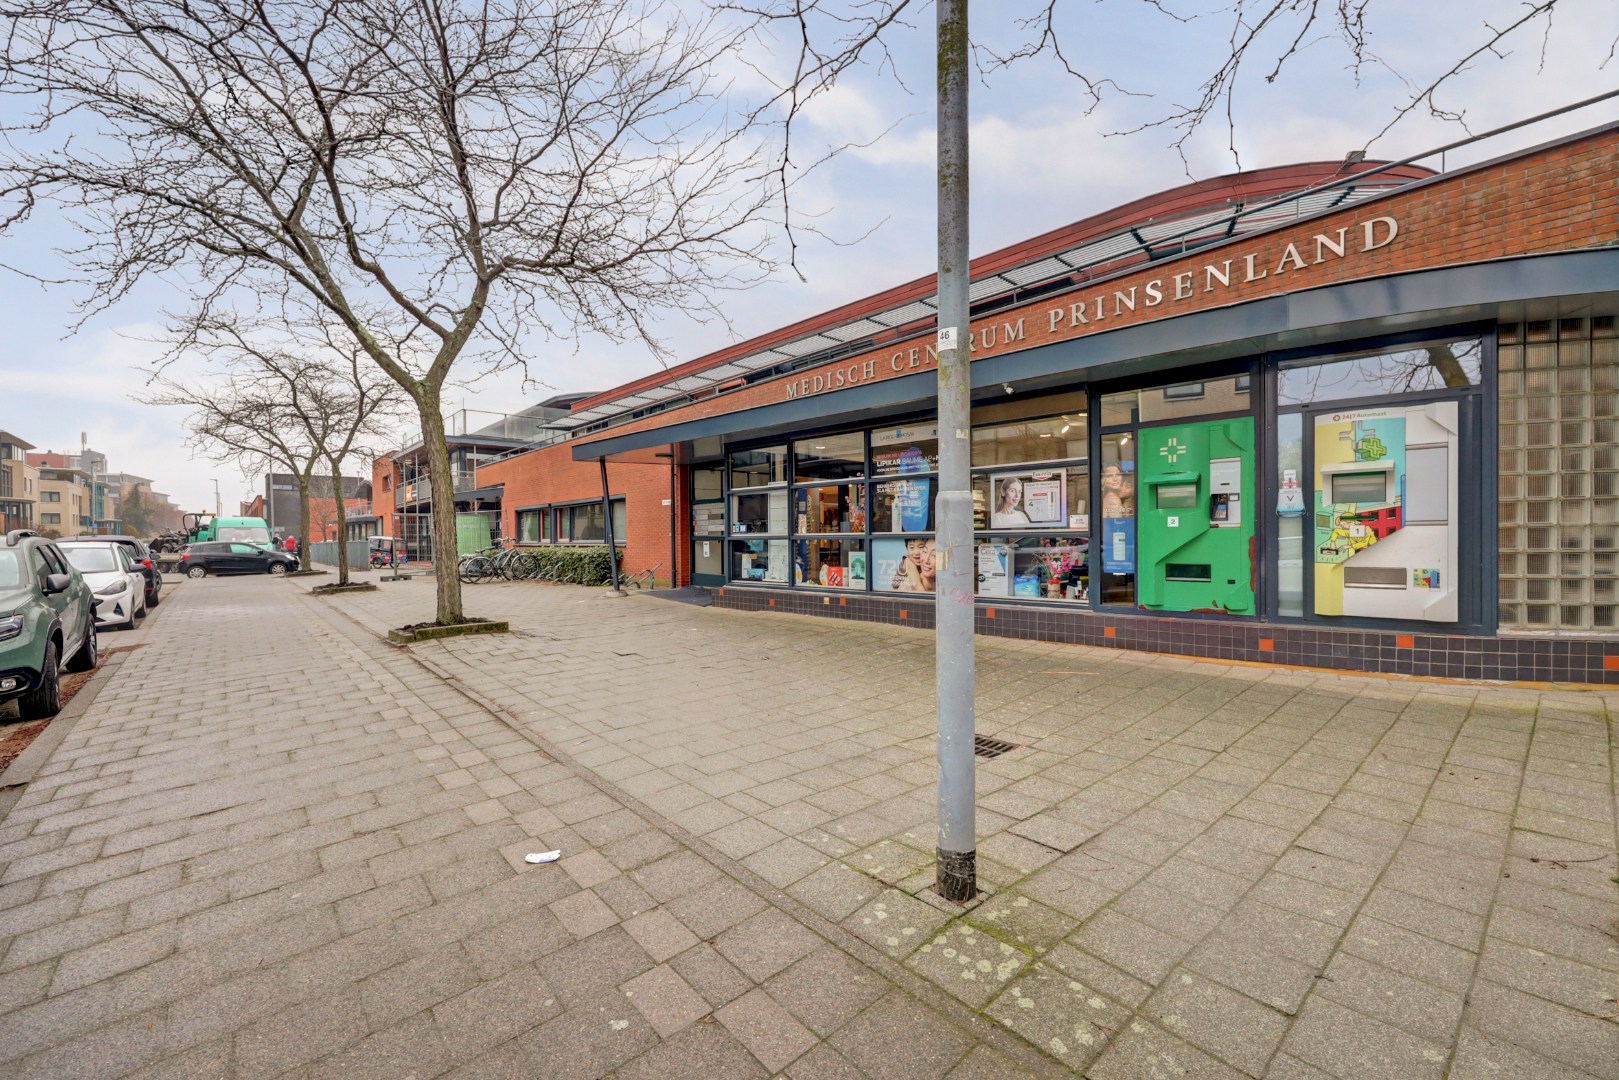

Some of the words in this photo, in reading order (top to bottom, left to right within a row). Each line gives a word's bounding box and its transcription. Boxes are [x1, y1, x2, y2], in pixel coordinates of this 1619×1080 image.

[786, 360, 876, 400] MEDISCH
[891, 318, 1026, 373] CENUM
[1048, 215, 1399, 333] PRINSENLAND
[939, 330, 950, 340] 46
[876, 459, 901, 467] LIPIKAR
